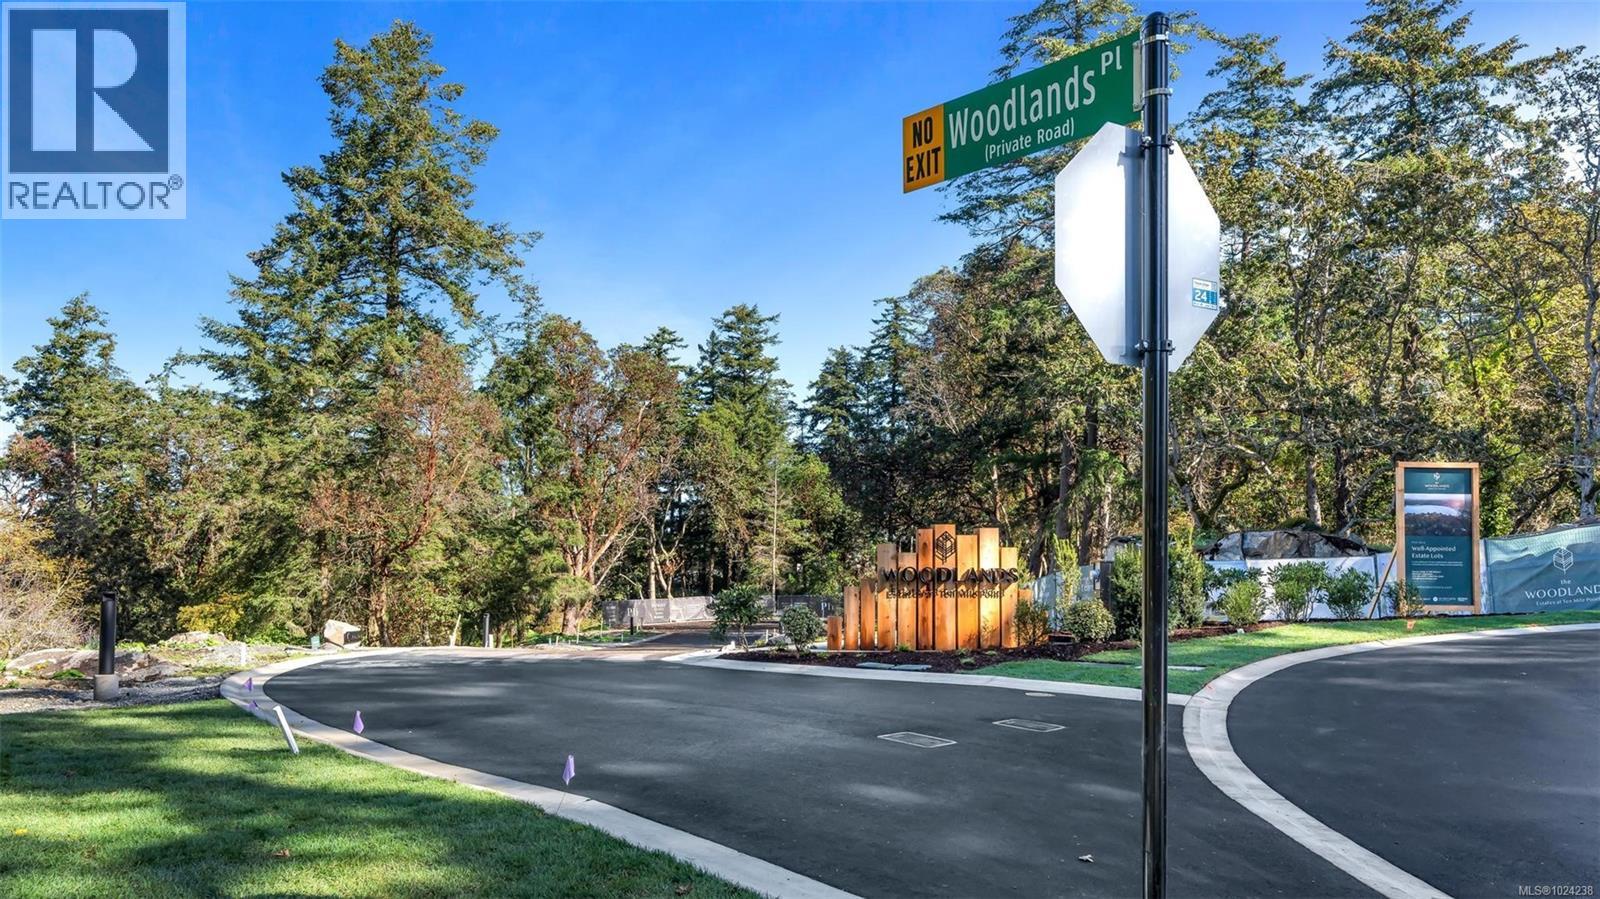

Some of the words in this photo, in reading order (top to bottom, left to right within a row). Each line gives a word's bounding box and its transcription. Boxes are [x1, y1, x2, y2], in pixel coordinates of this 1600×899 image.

[949, 65, 1096, 149] Woodlands
[1101, 46, 1122, 76] Pl
[912, 116, 933, 149] NO
[984, 134, 1032, 163] (Private
[1037, 117, 1075, 145] Road)
[906, 146, 941, 183] EXIT
[1195, 290, 1207, 302] 24
[882, 566, 1019, 584] WOODLANDS
